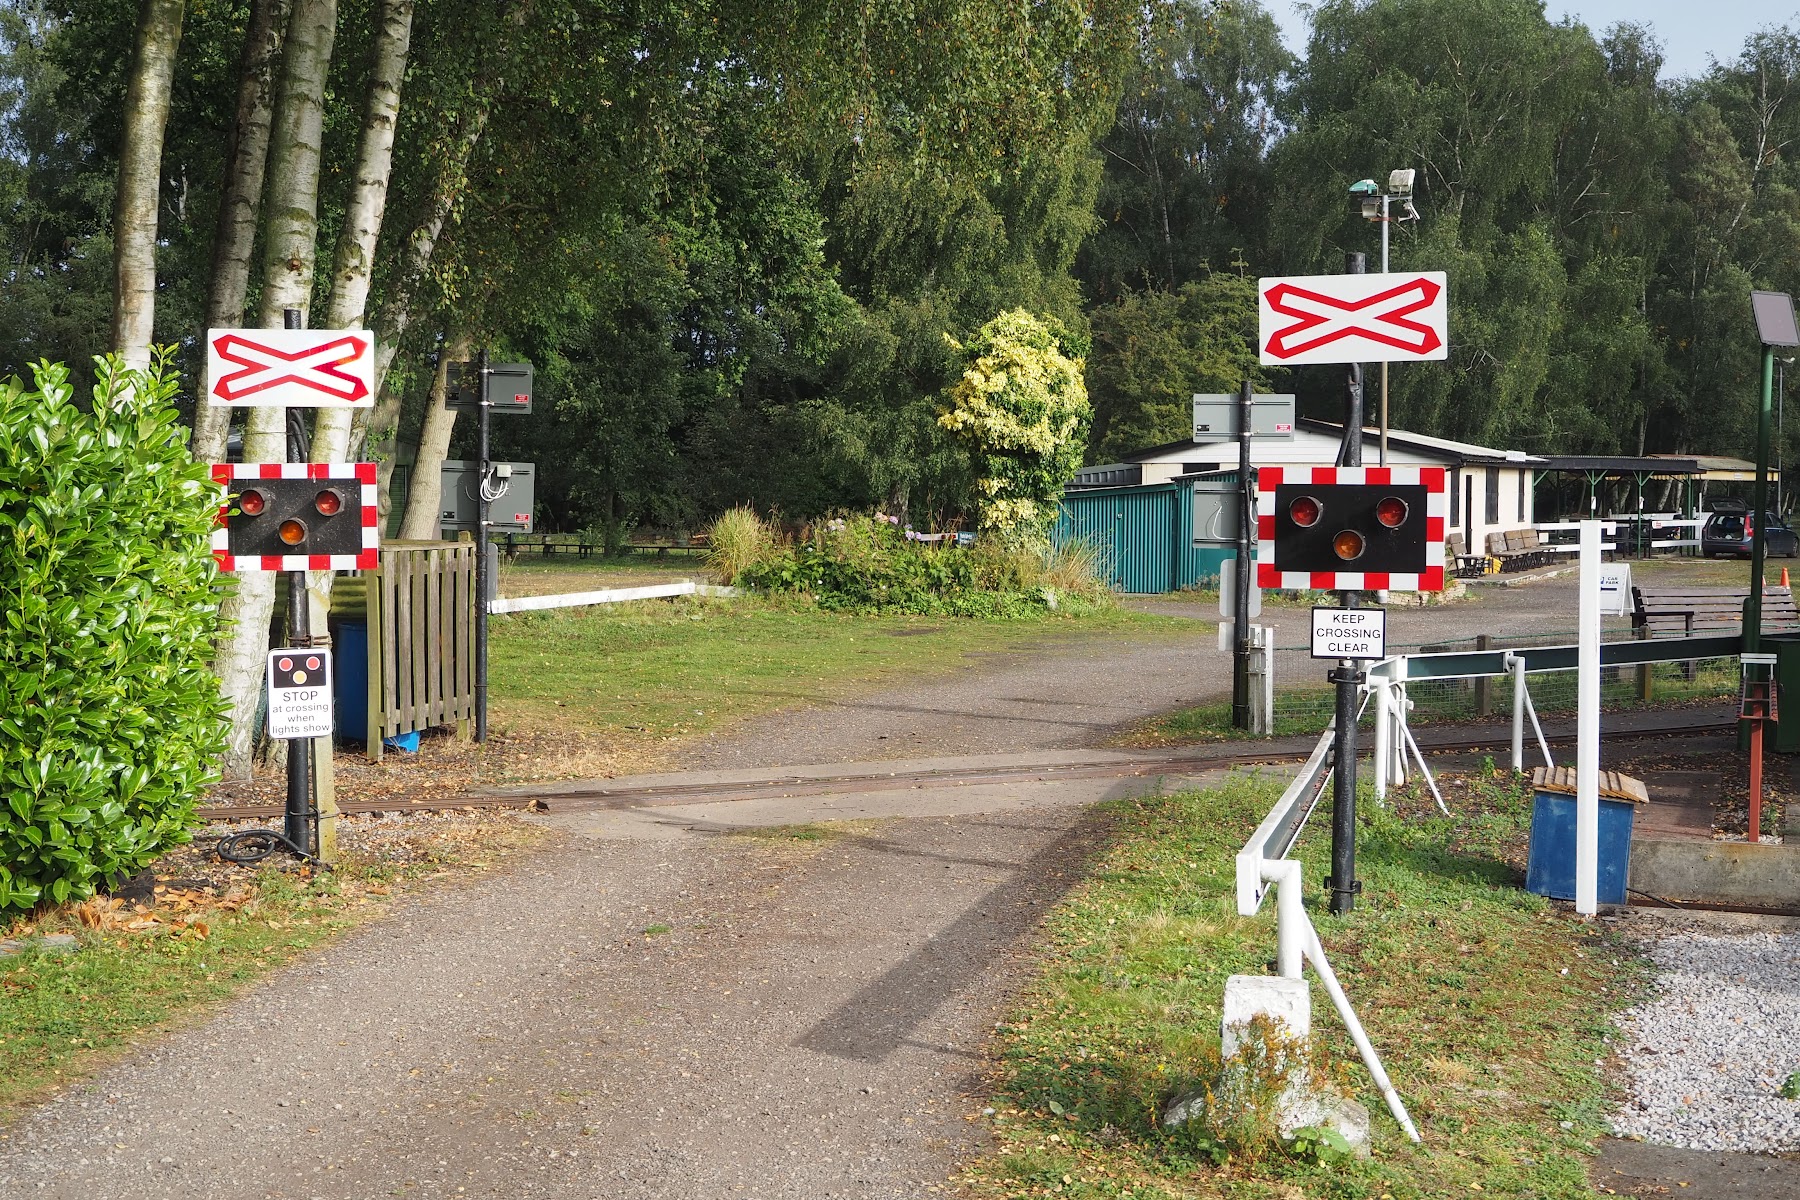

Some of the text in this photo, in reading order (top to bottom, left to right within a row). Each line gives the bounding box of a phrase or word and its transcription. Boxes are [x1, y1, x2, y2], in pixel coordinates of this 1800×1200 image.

[1333, 614, 1365, 624] KEEP
[1316, 628, 1381, 639] CROSSING
[1328, 642, 1369, 653] CLEAR
[283, 690, 318, 702] STOP
[272, 703, 329, 713] at crossing
[287, 714, 315, 723] when
[272, 724, 330, 735] lights show
